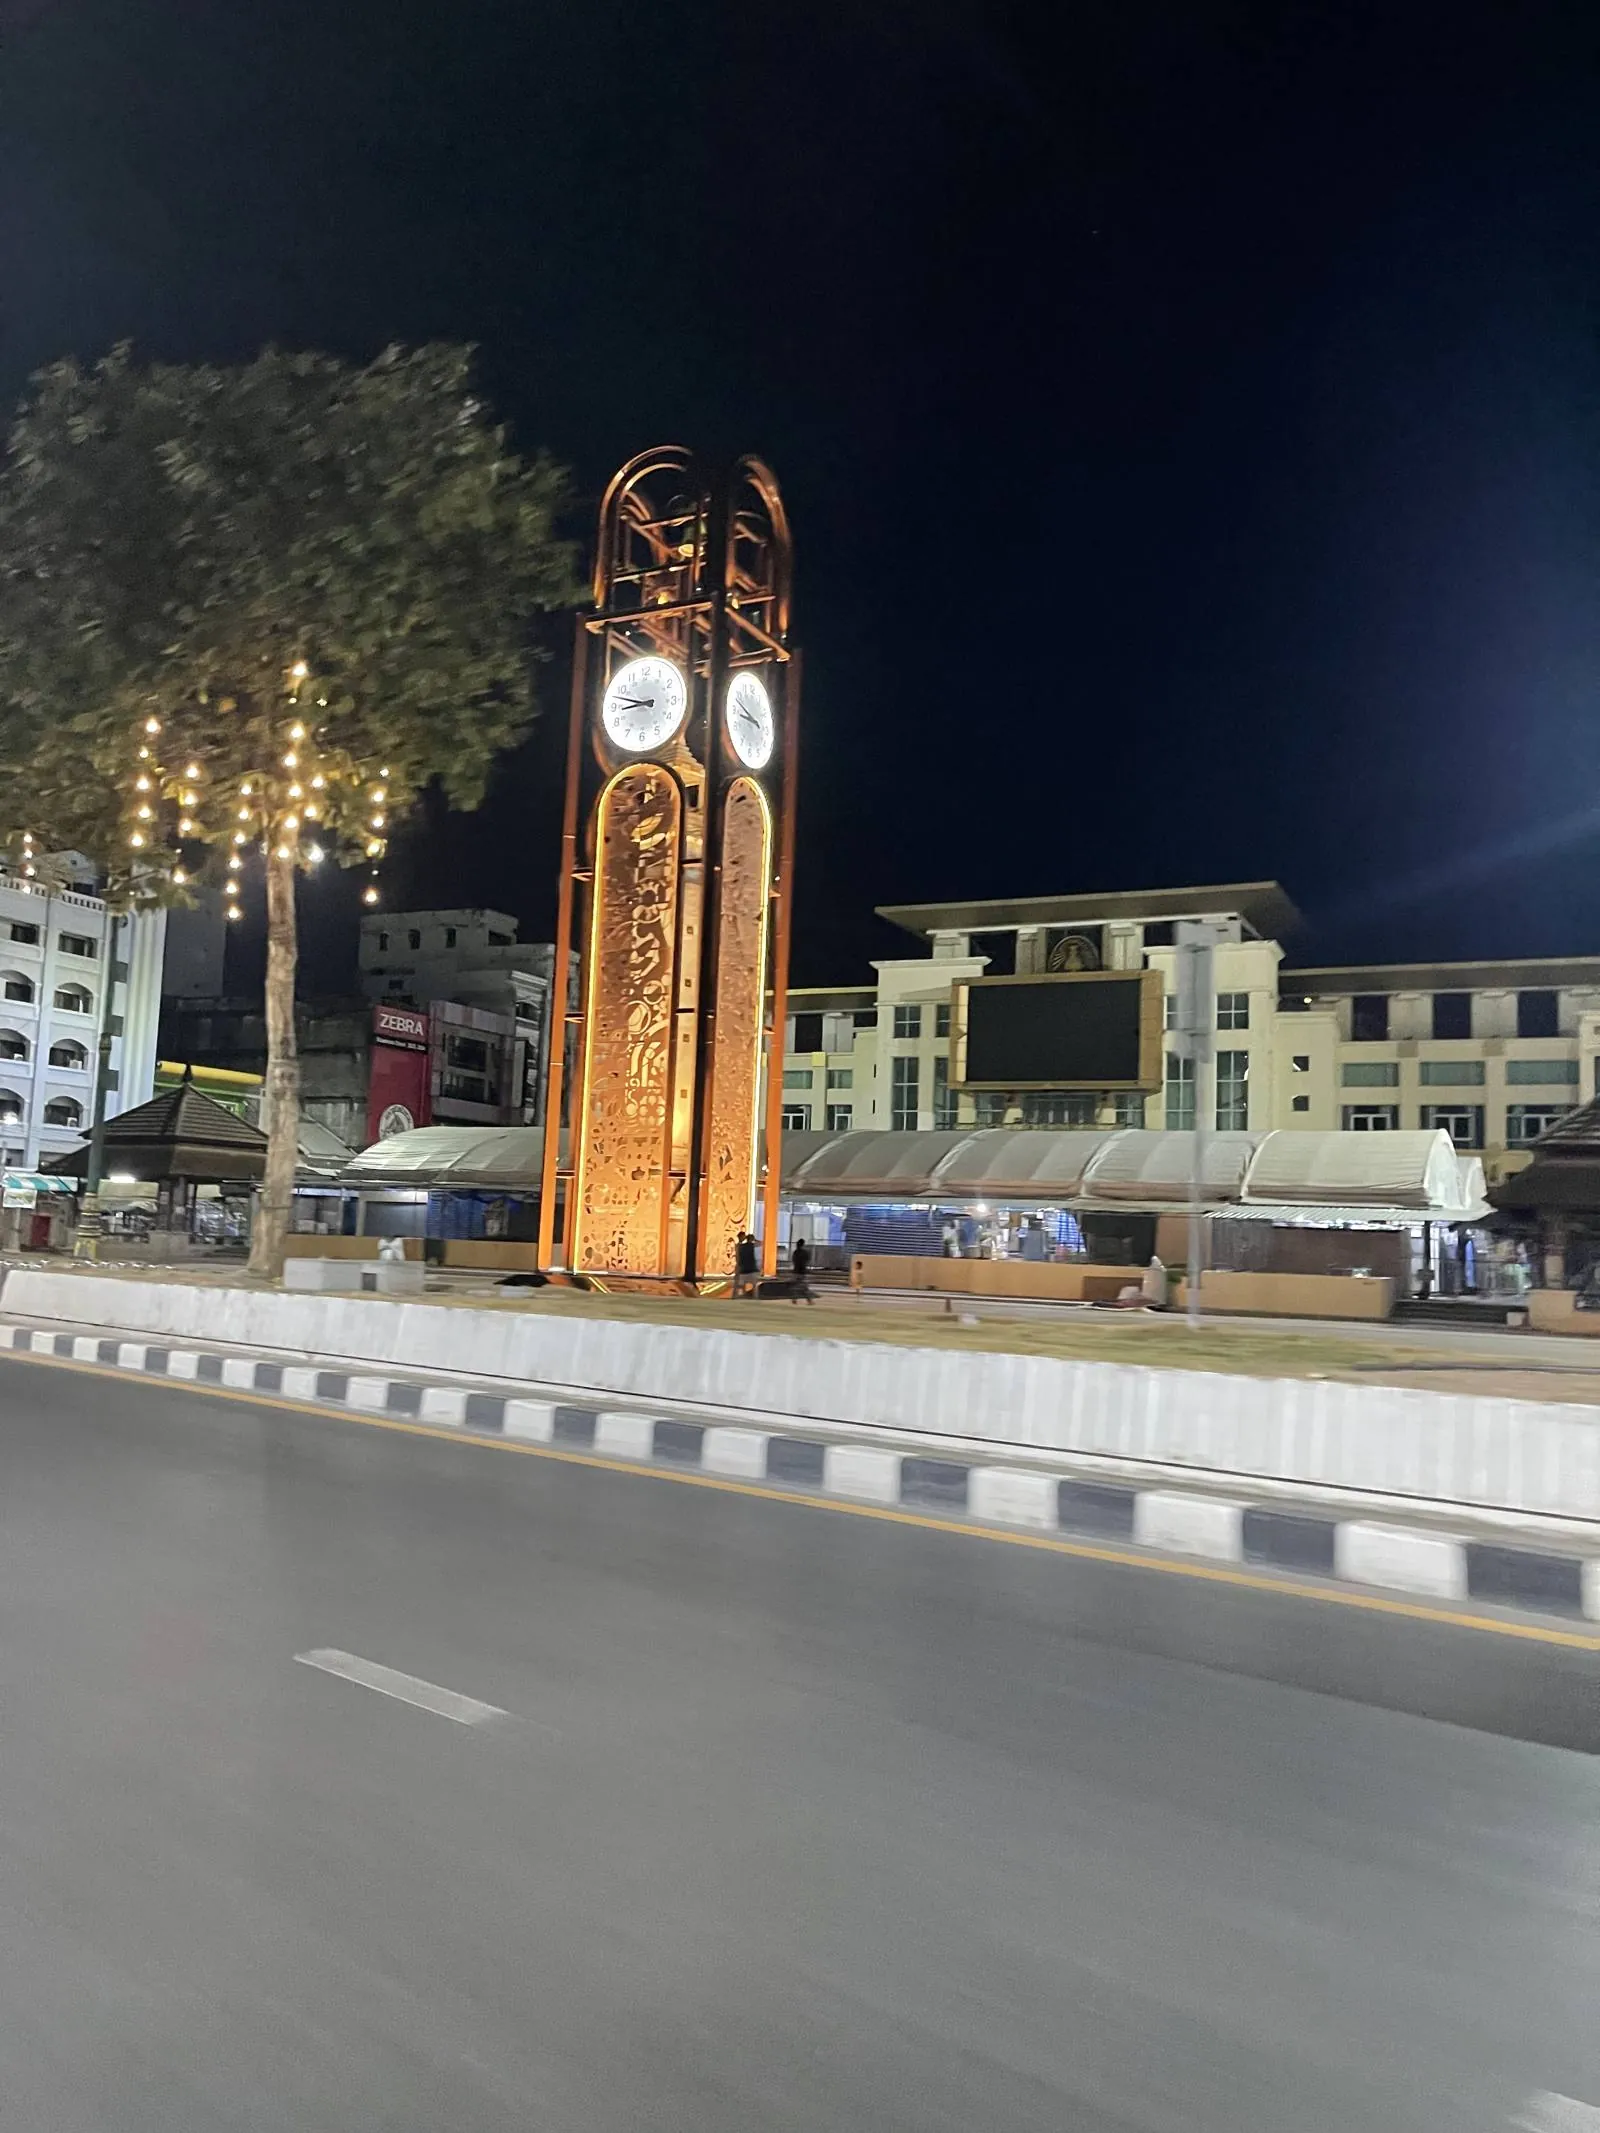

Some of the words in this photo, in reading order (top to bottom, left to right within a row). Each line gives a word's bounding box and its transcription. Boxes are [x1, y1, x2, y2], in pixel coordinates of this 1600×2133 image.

[642, 667, 651, 676] 12
[629, 672, 635, 682] 11
[667, 679, 673, 689] 2
[618, 685, 627, 694] 10
[671, 696, 677, 706] 3
[611, 703, 617, 712] 9
[666, 712, 672, 720] 4
[614, 717, 620, 727] 8
[625, 728, 631, 737] 7
[654, 726, 660, 736] 5
[639, 732, 645, 742] 6
[380, 1014, 424, 1036] ZEBRA
